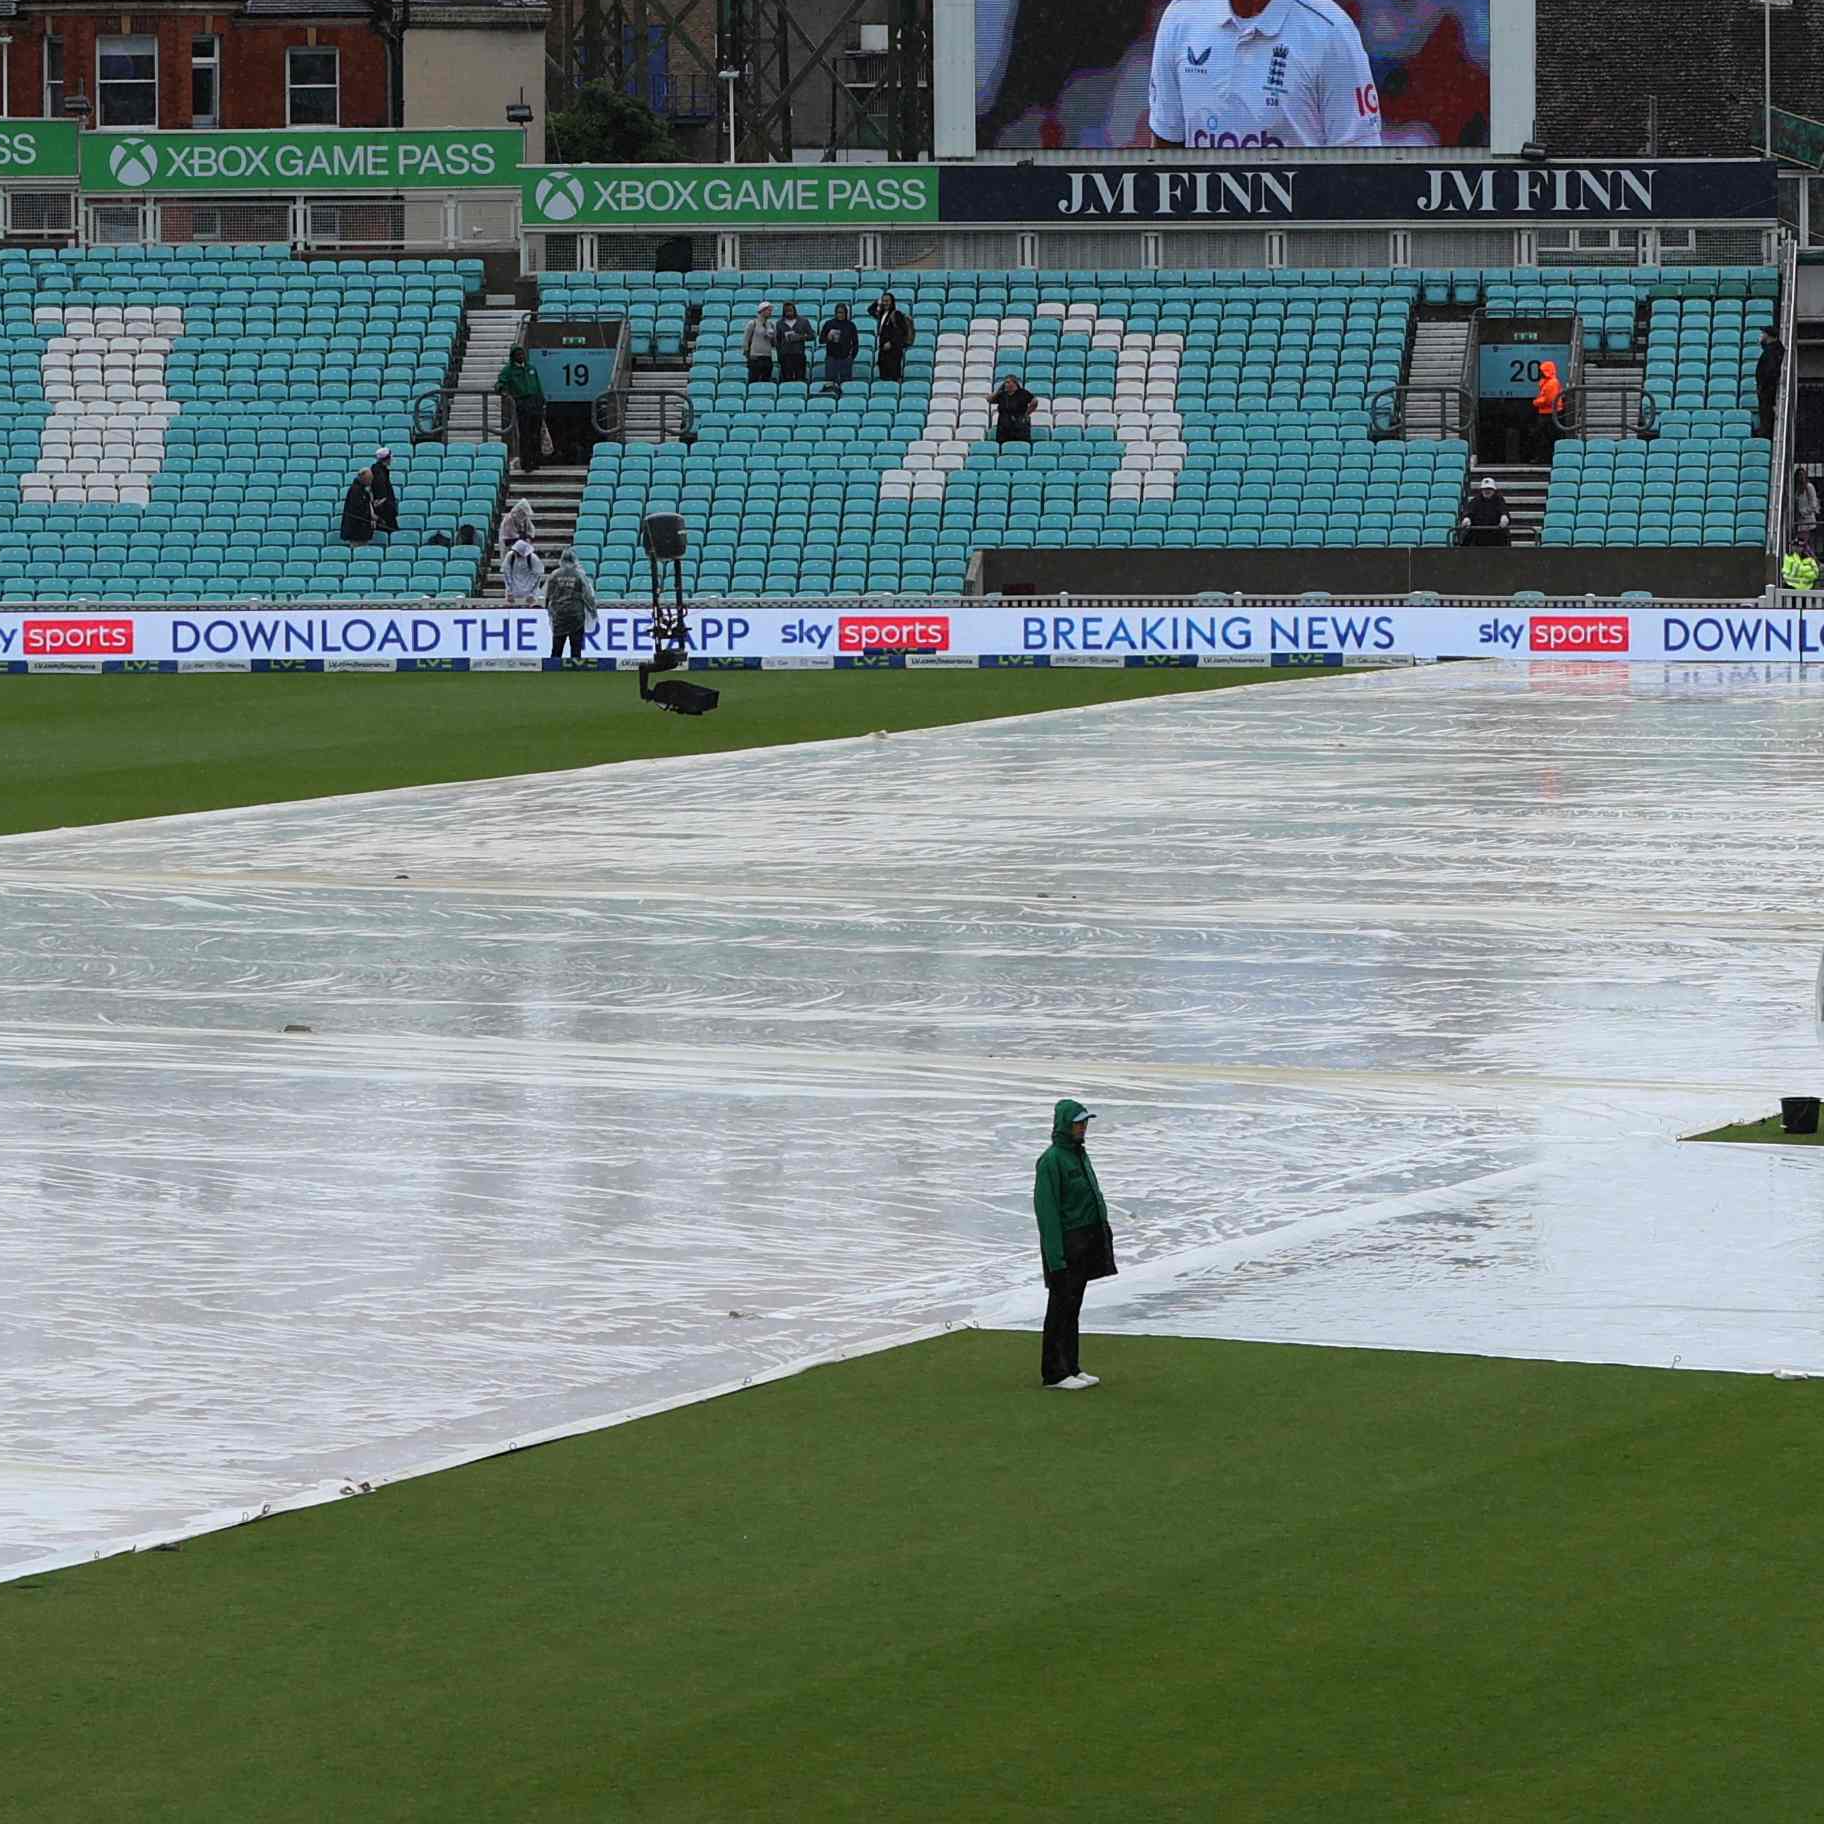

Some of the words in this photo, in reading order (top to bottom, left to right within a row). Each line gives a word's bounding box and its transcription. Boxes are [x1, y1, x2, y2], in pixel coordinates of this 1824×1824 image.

[166, 145, 270, 177] XBOX
[275, 144, 389, 176] GAME
[398, 143, 496, 175] PASS
[593, 180, 699, 211] XBOX
[704, 179, 818, 211] GAME
[828, 178, 927, 210] PASS
[1058, 172, 1140, 215] JM
[1153, 171, 1299, 214] FINN
[1417, 169, 1500, 212] JM
[1512, 169, 1658, 212] FINN
[561, 363, 590, 387] 19
[1509, 359, 1542, 383] 20
[28, 624, 128, 652] sports
[172, 619, 441, 654] DOWNLOAD
[454, 618, 538, 652] THE
[580, 617, 654, 651] REE
[781, 619, 833, 650] sky
[844, 622, 943, 648] sports
[1024, 616, 1253, 651] BREAKING
[1270, 616, 1395, 650] NEWS
[1479, 617, 1525, 649] sky
[1535, 620, 1624, 648] sports
